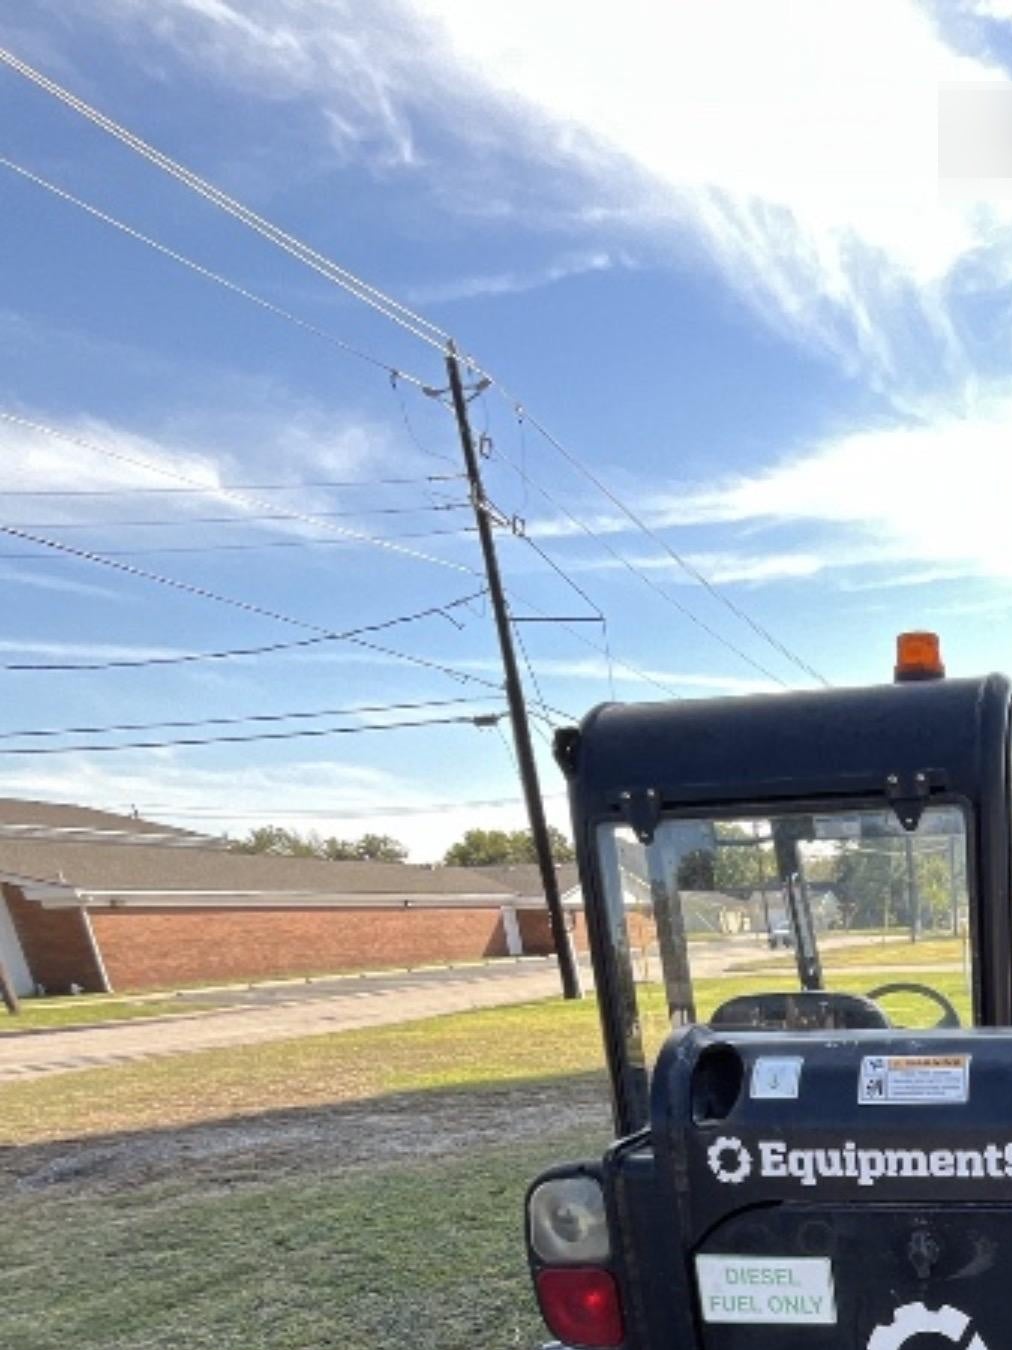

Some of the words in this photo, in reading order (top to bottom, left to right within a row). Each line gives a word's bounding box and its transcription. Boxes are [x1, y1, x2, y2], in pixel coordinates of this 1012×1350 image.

[725, 1267, 800, 1287] DIESEL
[709, 1295, 761, 1314] FUEL
[767, 1295, 823, 1315] ONLY
